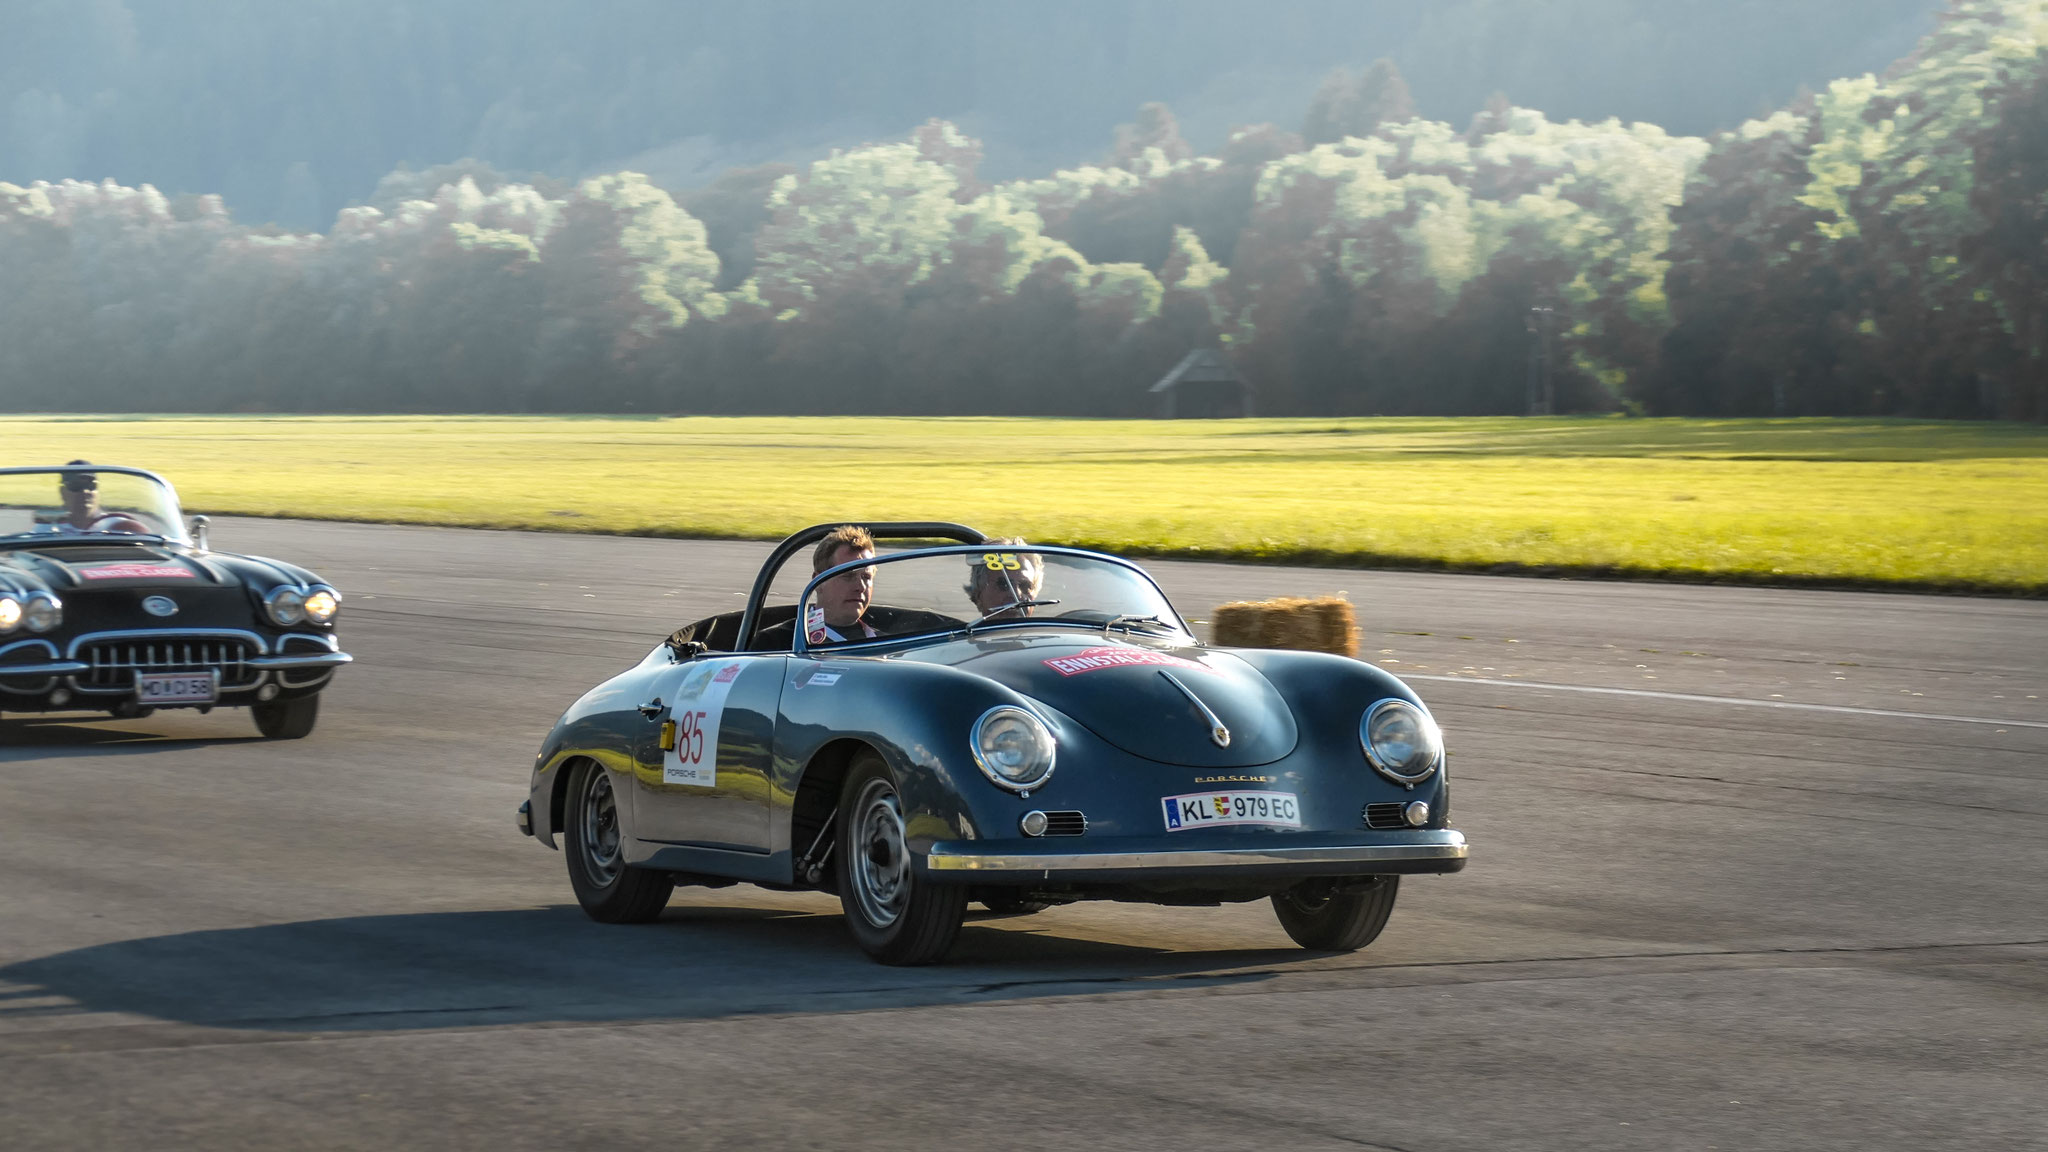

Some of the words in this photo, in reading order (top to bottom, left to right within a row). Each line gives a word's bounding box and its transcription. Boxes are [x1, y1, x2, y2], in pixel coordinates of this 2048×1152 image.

[983, 553, 1021, 571] 85
[679, 710, 707, 765] 85
[667, 768, 697, 779] PORSCHE
[1194, 775, 1267, 783] PORSCHE
[1182, 800, 1213, 821] KL
[1234, 797, 1268, 817] 979
[1271, 798, 1295, 819] EC
[1171, 818, 1178, 826] A
